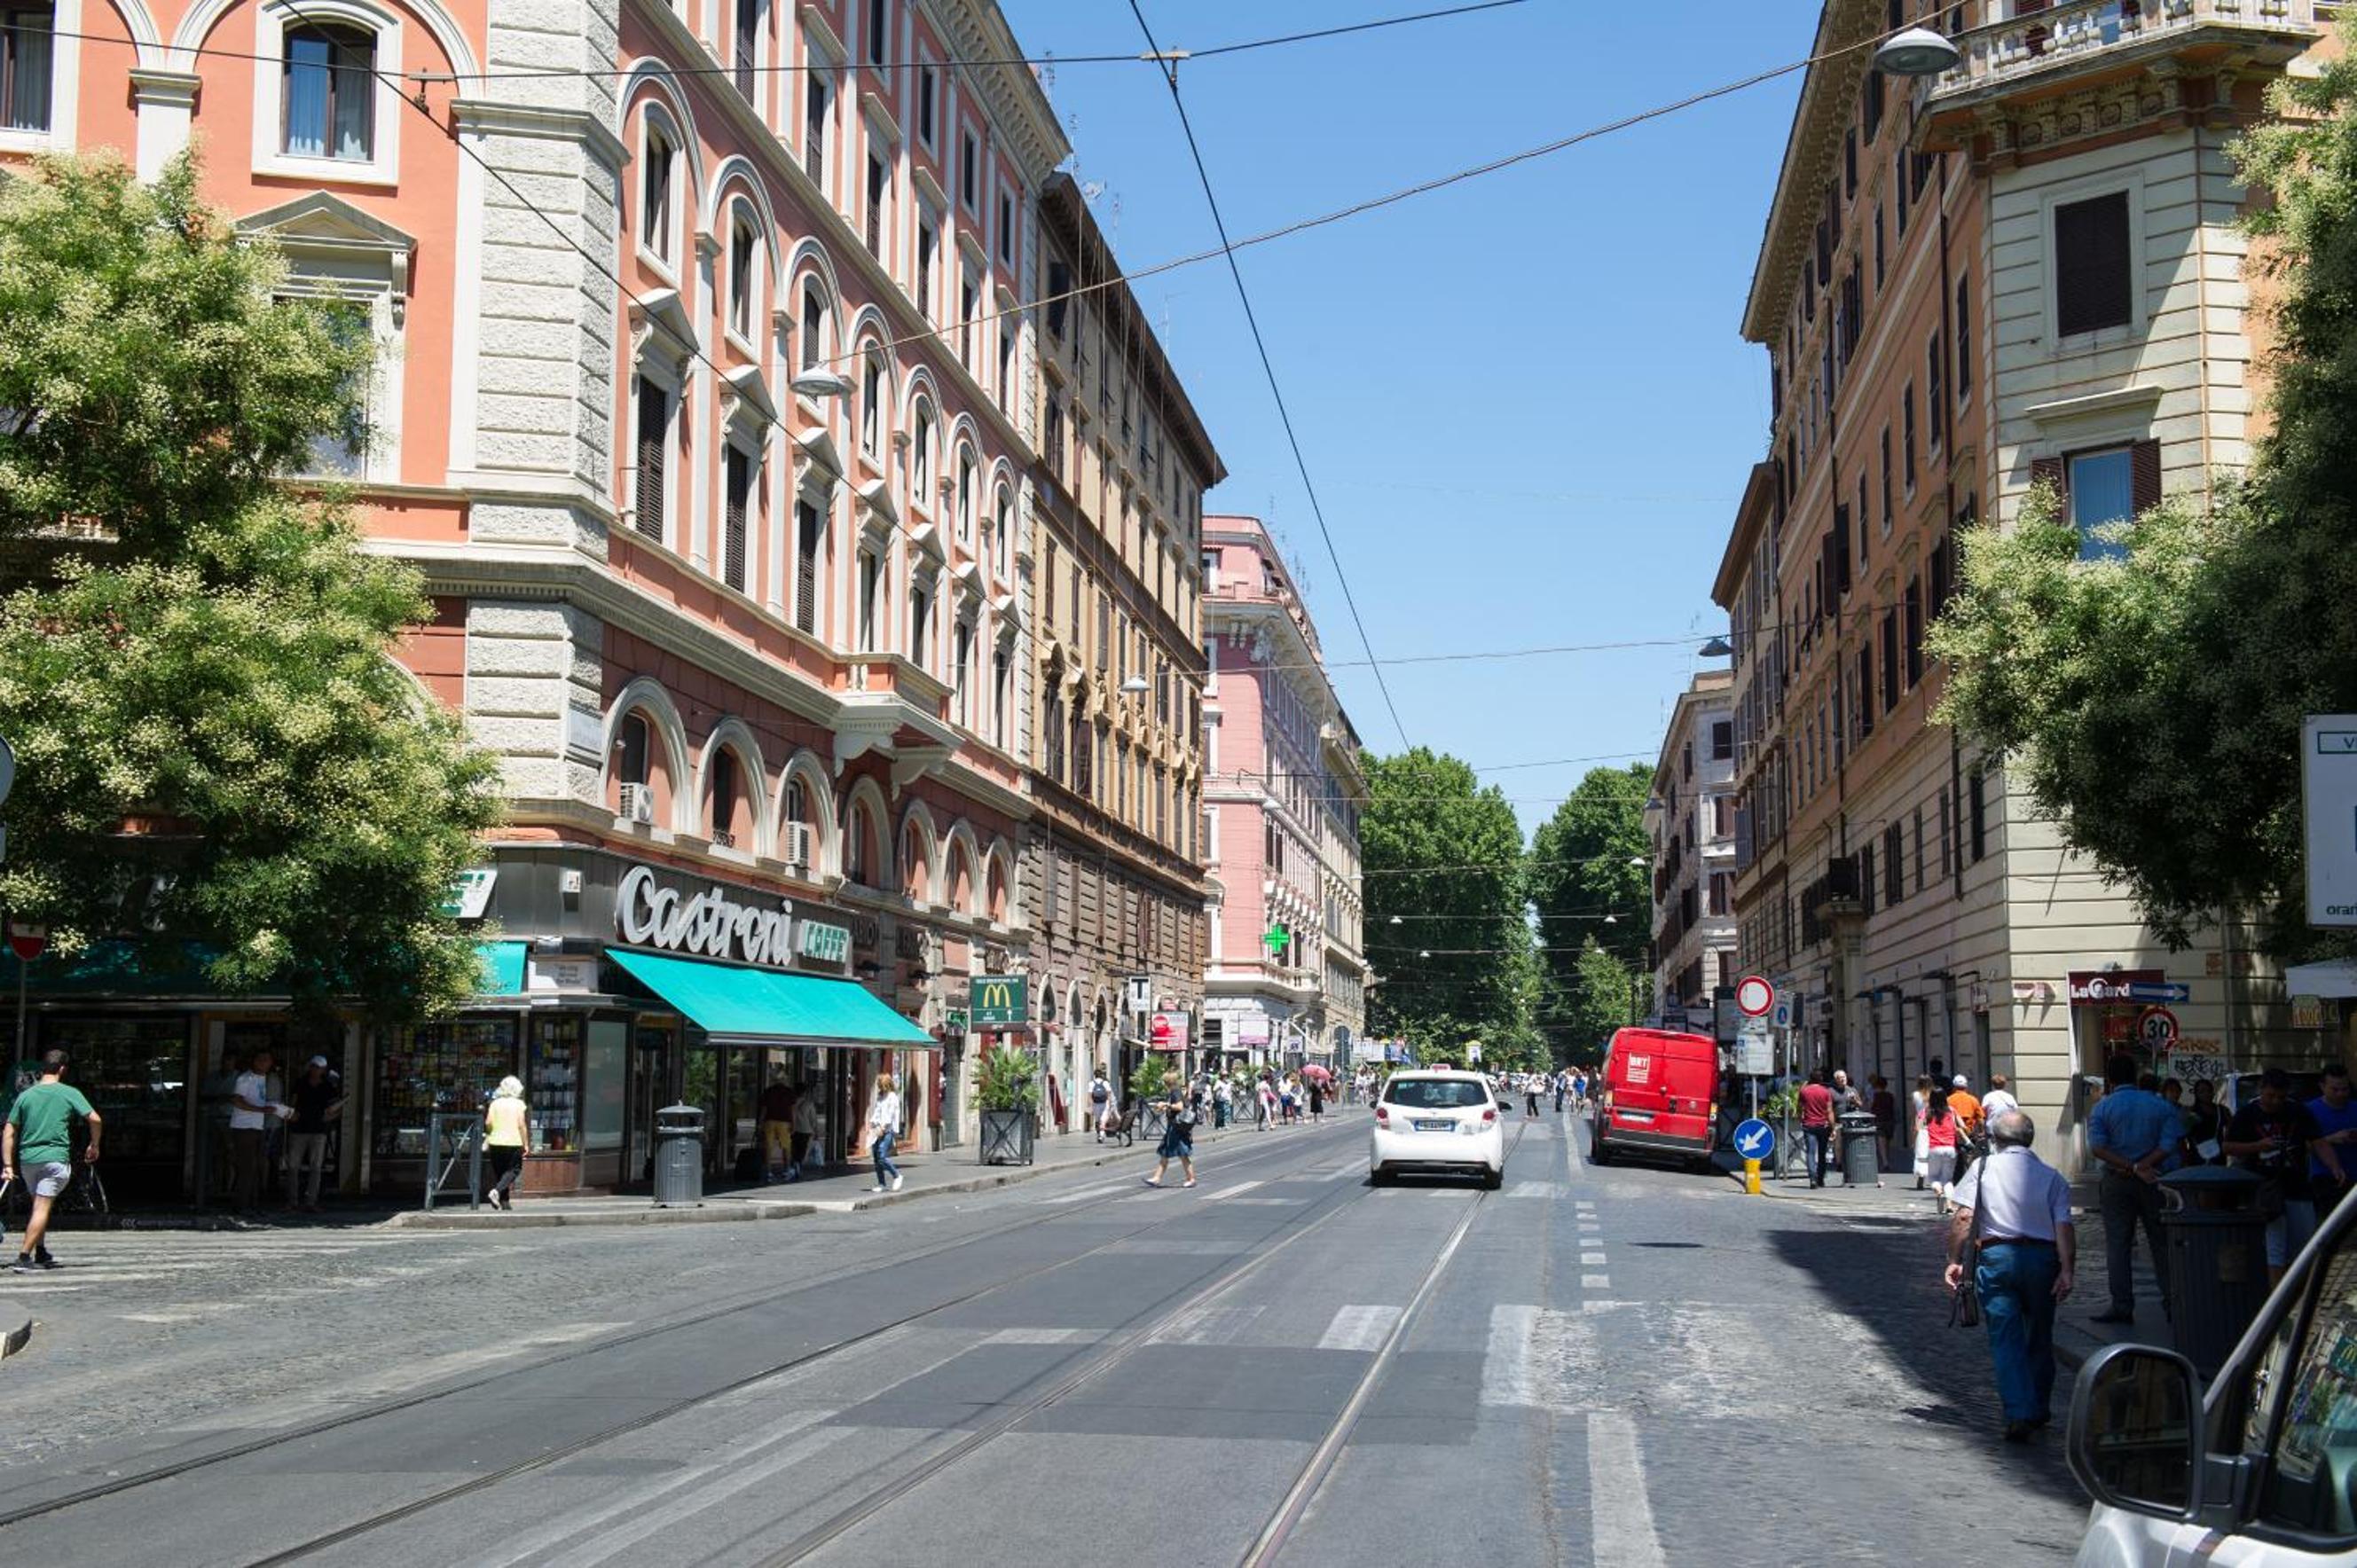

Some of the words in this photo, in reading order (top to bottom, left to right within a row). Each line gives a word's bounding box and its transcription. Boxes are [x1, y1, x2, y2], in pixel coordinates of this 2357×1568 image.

[616, 865, 791, 966] Castroni
[1131, 978, 1149, 1000] T
[2070, 977, 2130, 999] LaGard
[2147, 1019, 2170, 1040] 30
